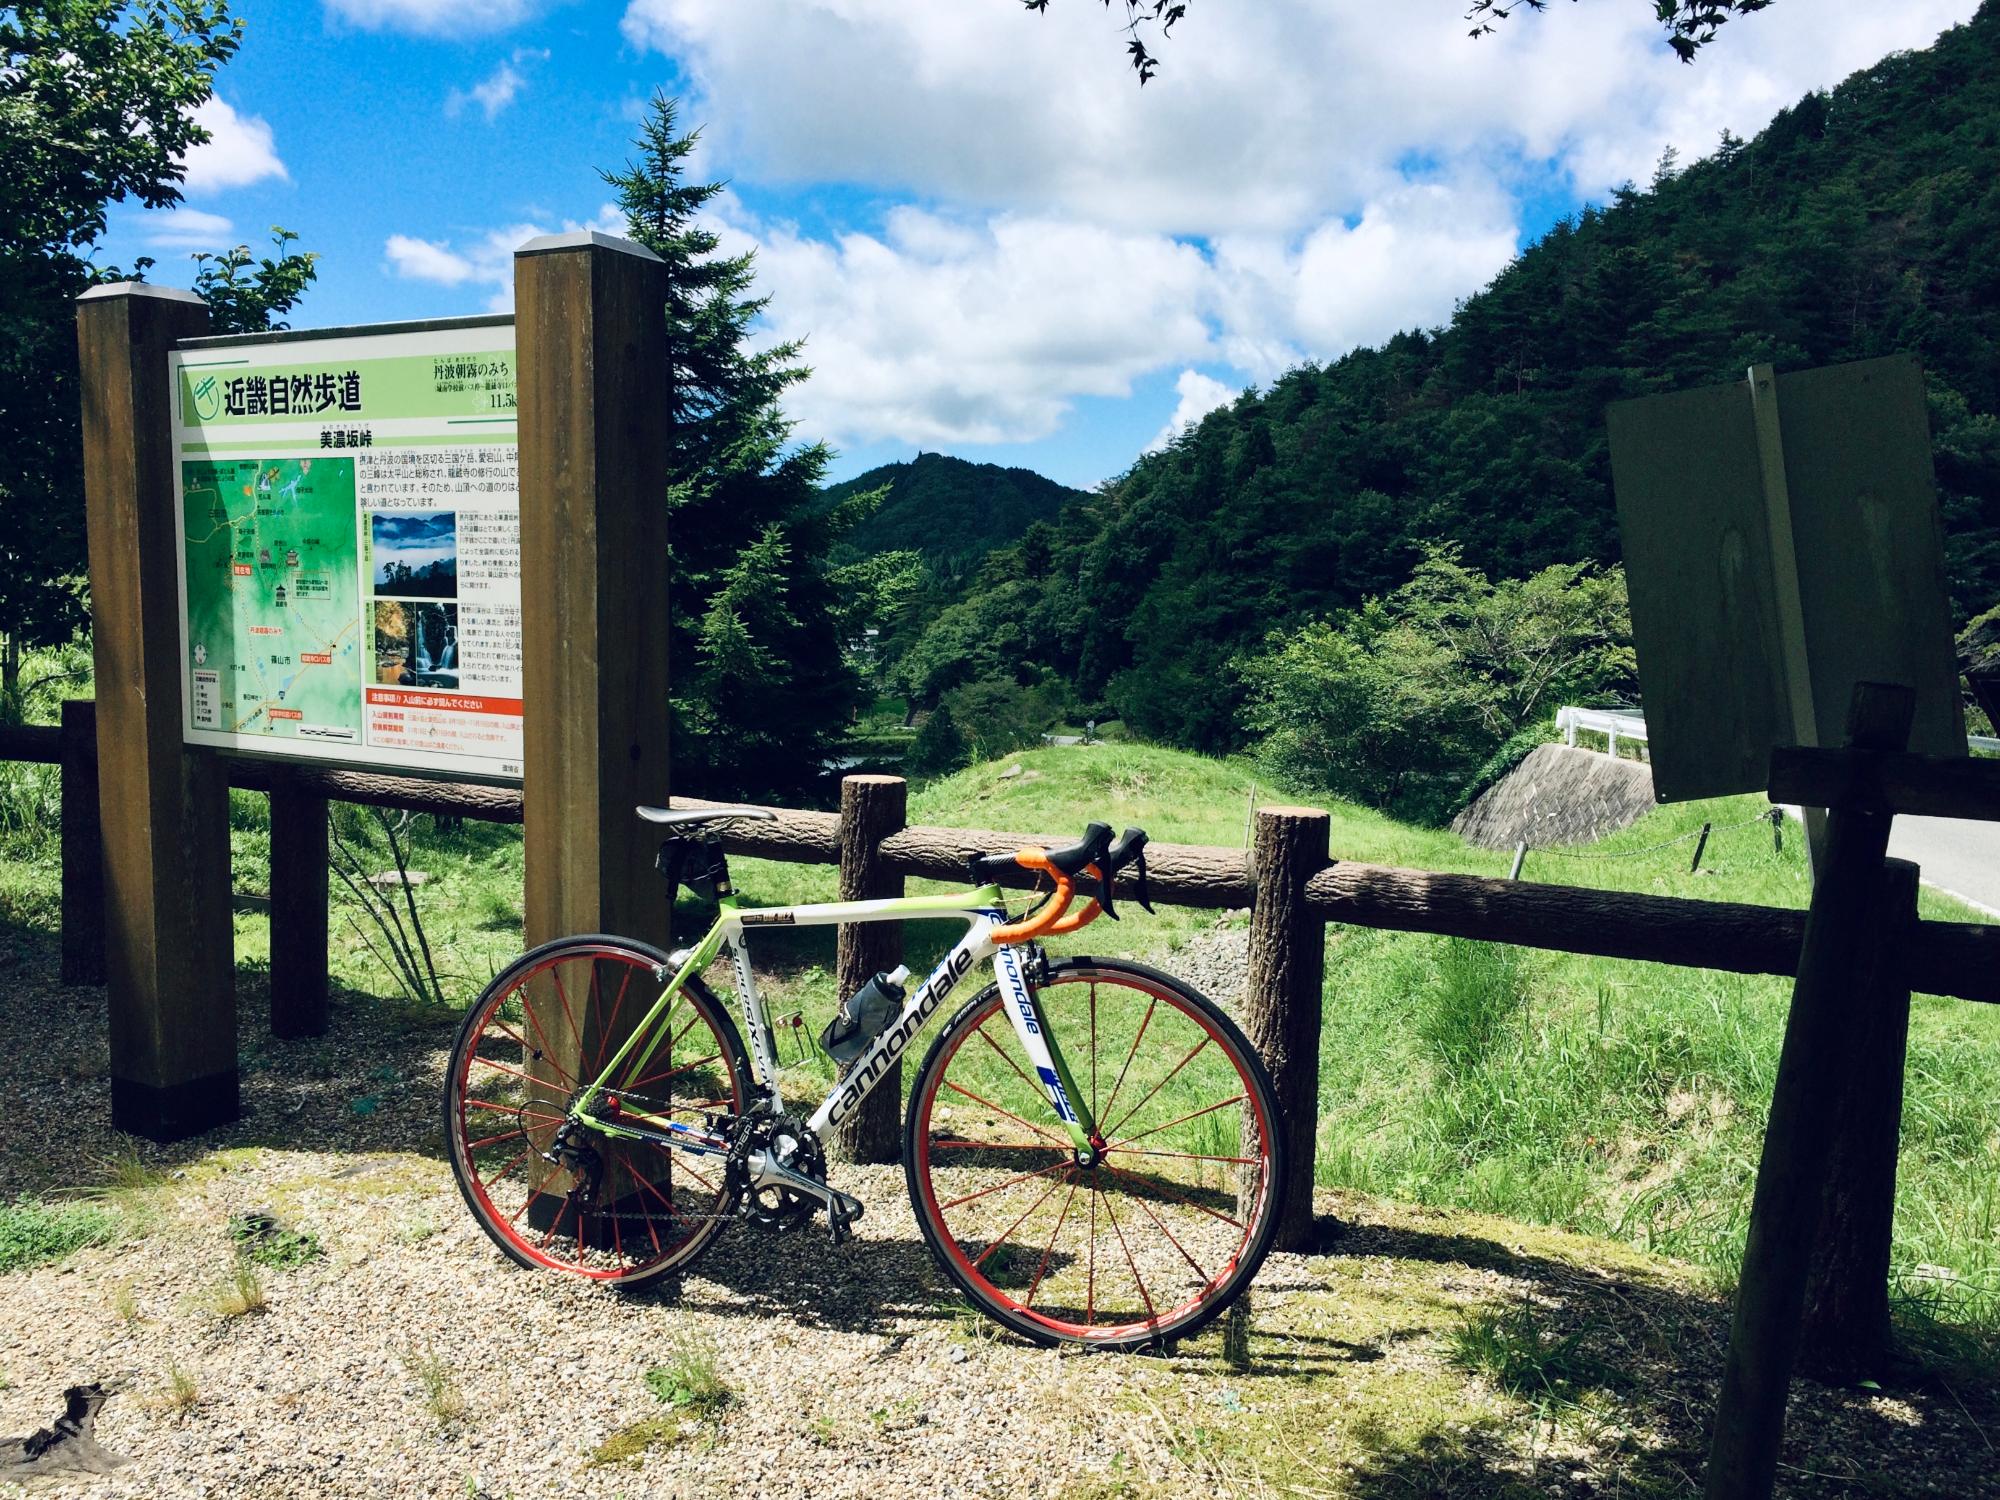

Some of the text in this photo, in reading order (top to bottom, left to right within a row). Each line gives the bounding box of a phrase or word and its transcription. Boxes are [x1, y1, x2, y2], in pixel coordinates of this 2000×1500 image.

[433, 361, 509, 380] 丹波朝霧のみち
[224, 370, 361, 416] 近畿自然歩道
[490, 394, 518, 408] 11.5k
[320, 430, 373, 449] 美濃坂峠
[828, 947, 974, 1127] cannondale
